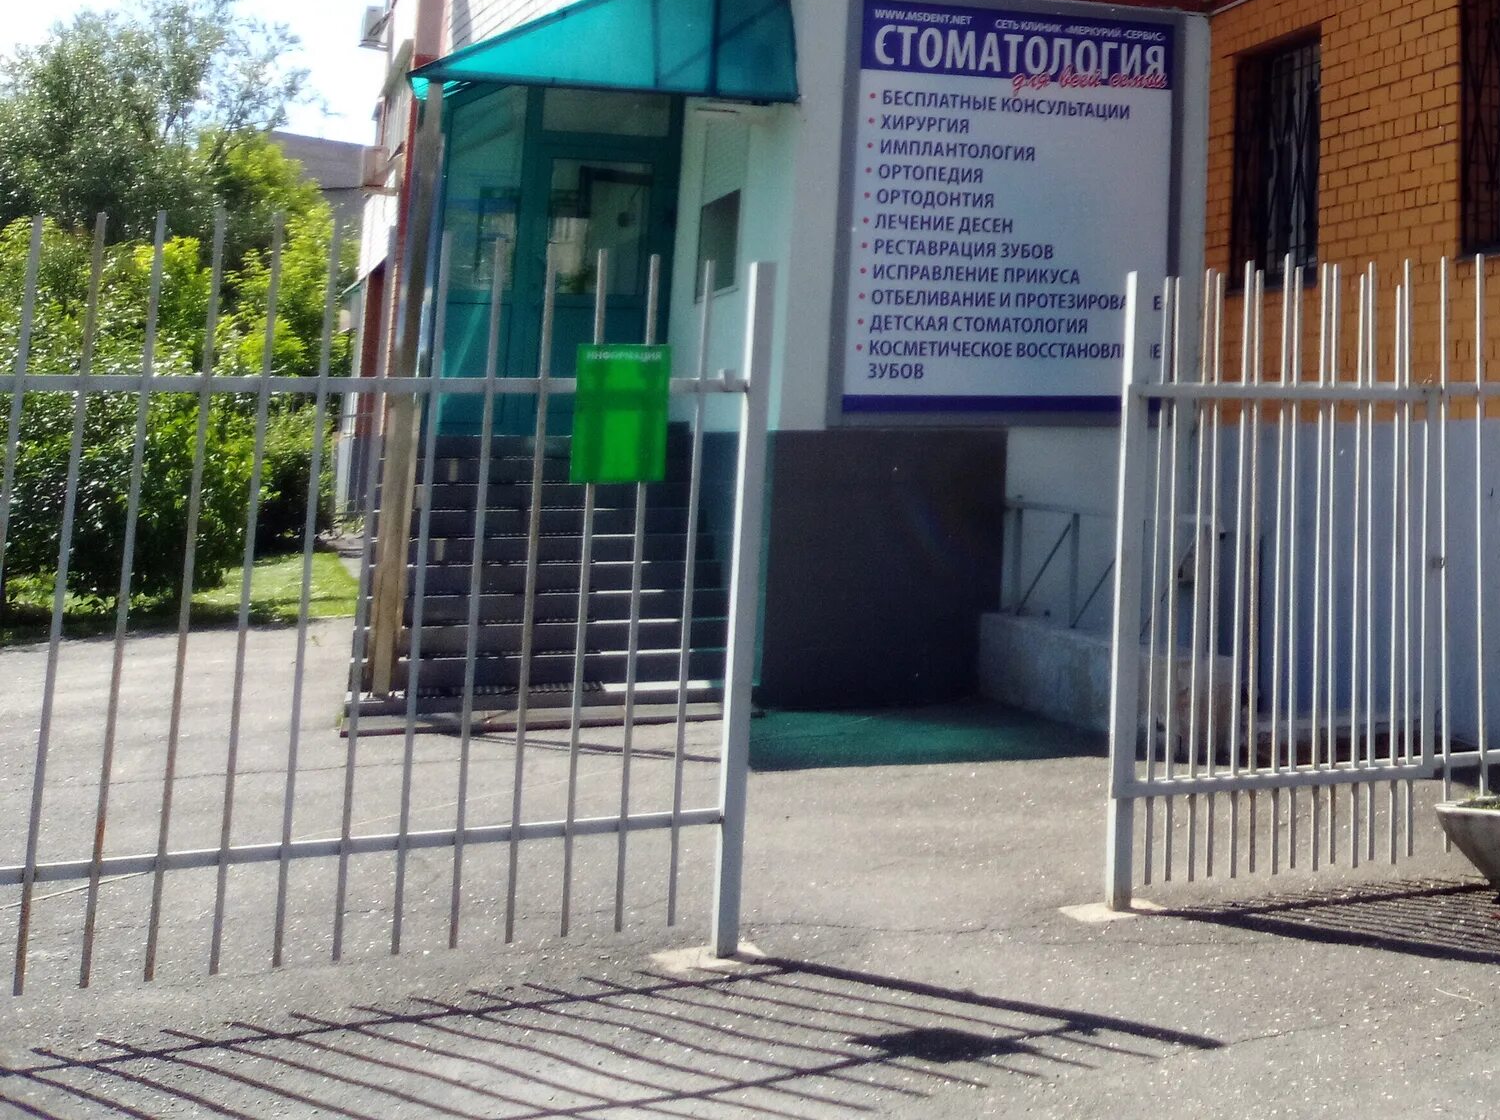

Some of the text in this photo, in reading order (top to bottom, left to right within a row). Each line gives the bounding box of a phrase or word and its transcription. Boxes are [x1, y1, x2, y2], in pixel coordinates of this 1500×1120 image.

[874, 10, 972, 24] WWW.MSDENT.NET
[995, 19, 1018, 29] СЕТЬ
[1020, 22, 1062, 33] КЛИНИК
[874, 24, 1166, 80] СТОМАТОЛОГИЯ
[882, 90, 1130, 120] БЕСПЛАТНЫЕ КОНСУЛЬТАЦИИ
[880, 115, 969, 134] ХИРУРГИЯ
[880, 140, 1035, 162] ИМПЛАНТОЛОГИЯ
[879, 165, 984, 184] ОРТОПЕДИЯ
[876, 189, 994, 210] ОРТОДОНТИЯ
[874, 214, 1013, 235] ЛЕЧЕНИЕ ДЕСЕН
[874, 240, 1053, 260] РЕСТАВРАЦИЯ ЗУБОВ
[873, 265, 1080, 285] ИСПРАВЛЕНИЕ ПРИКУСА
[871, 291, 1162, 312] ОТБЕЛИВАНИЕ И ПРОТЕЗИРОВАЕ
[869, 315, 1088, 334] ДЕТСКАЯ СТОМАТОЛОГИЯ
[869, 340, 1161, 359] КОСМЕТИЧЕСКОЕ ВОССТАНОВЛЕ
[867, 363, 924, 379] ЗУБОВ
